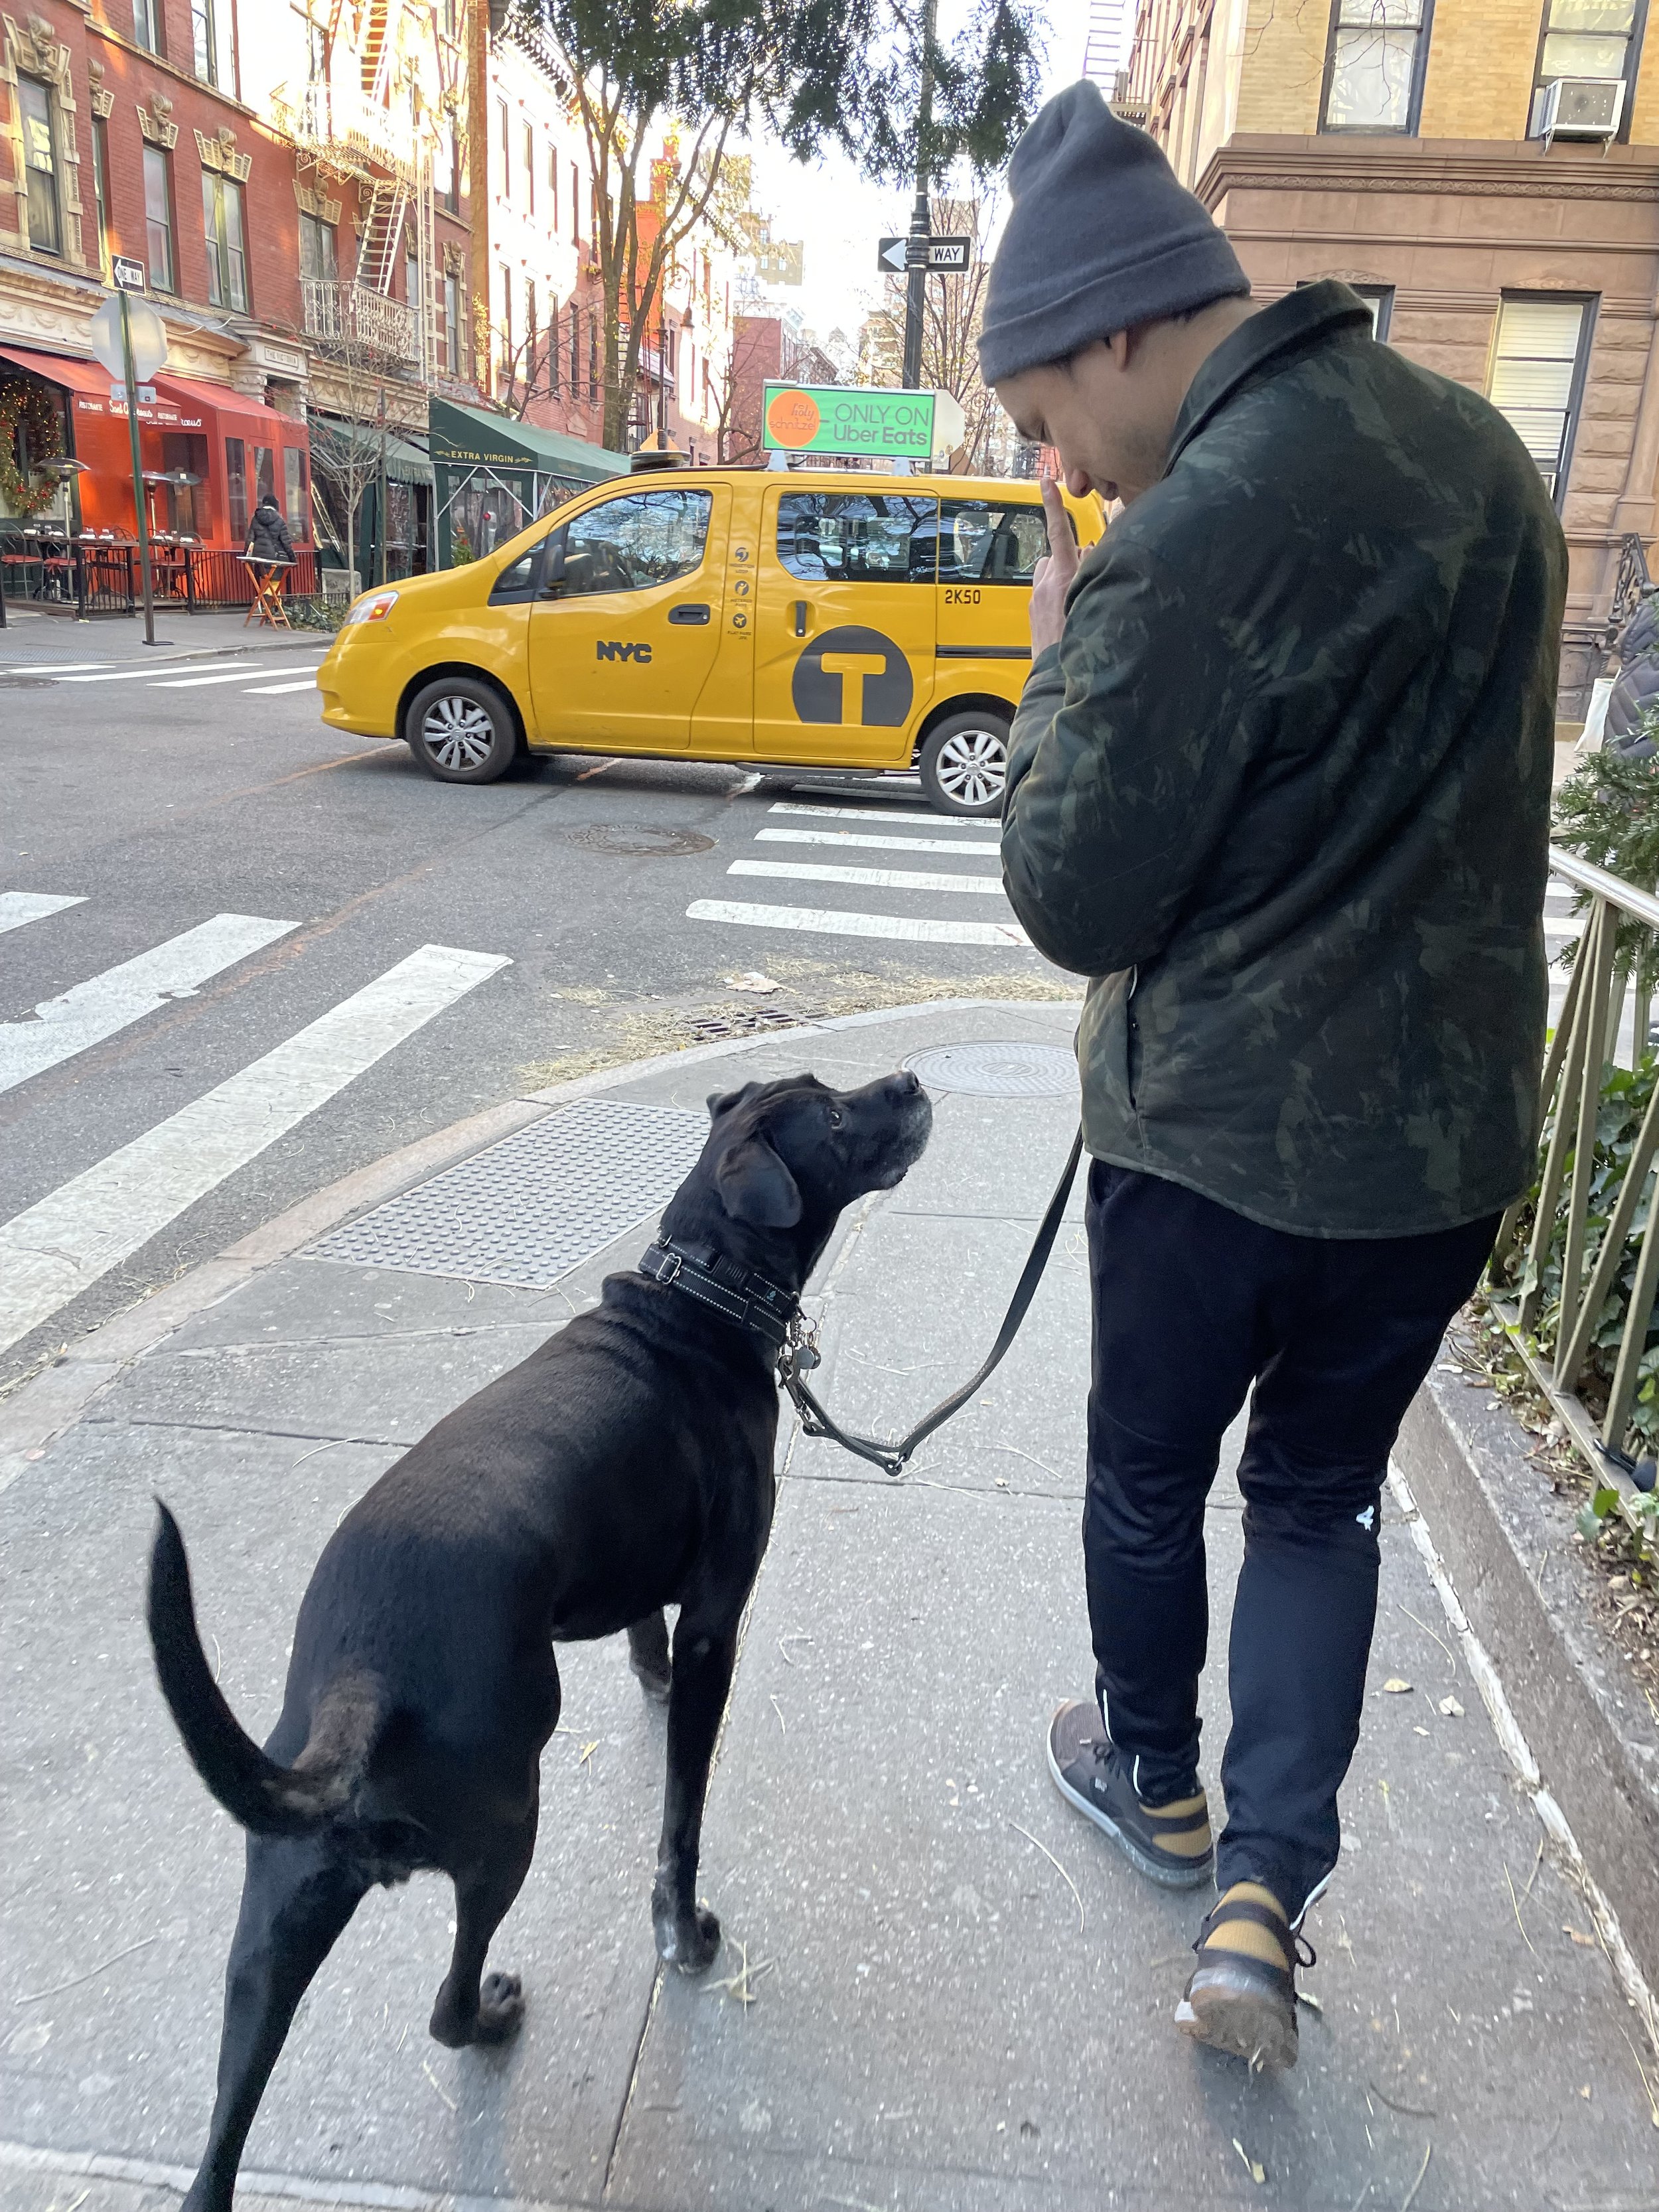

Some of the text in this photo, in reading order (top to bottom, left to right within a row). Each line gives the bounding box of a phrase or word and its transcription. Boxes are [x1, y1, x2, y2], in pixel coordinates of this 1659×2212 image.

[934, 248, 960, 261] WAY
[117, 266, 140, 283] ONE WAY
[791, 403, 814, 421] holy
[835, 403, 929, 426] ONLY ON
[769, 416, 816, 430] schnitzel
[833, 423, 928, 445] Uber Eats
[451, 451, 514, 463] EXTRA VIRGIN
[945, 589, 981, 605] 2K50
[597, 640, 652, 663] NYC
[821, 652, 886, 725] T
